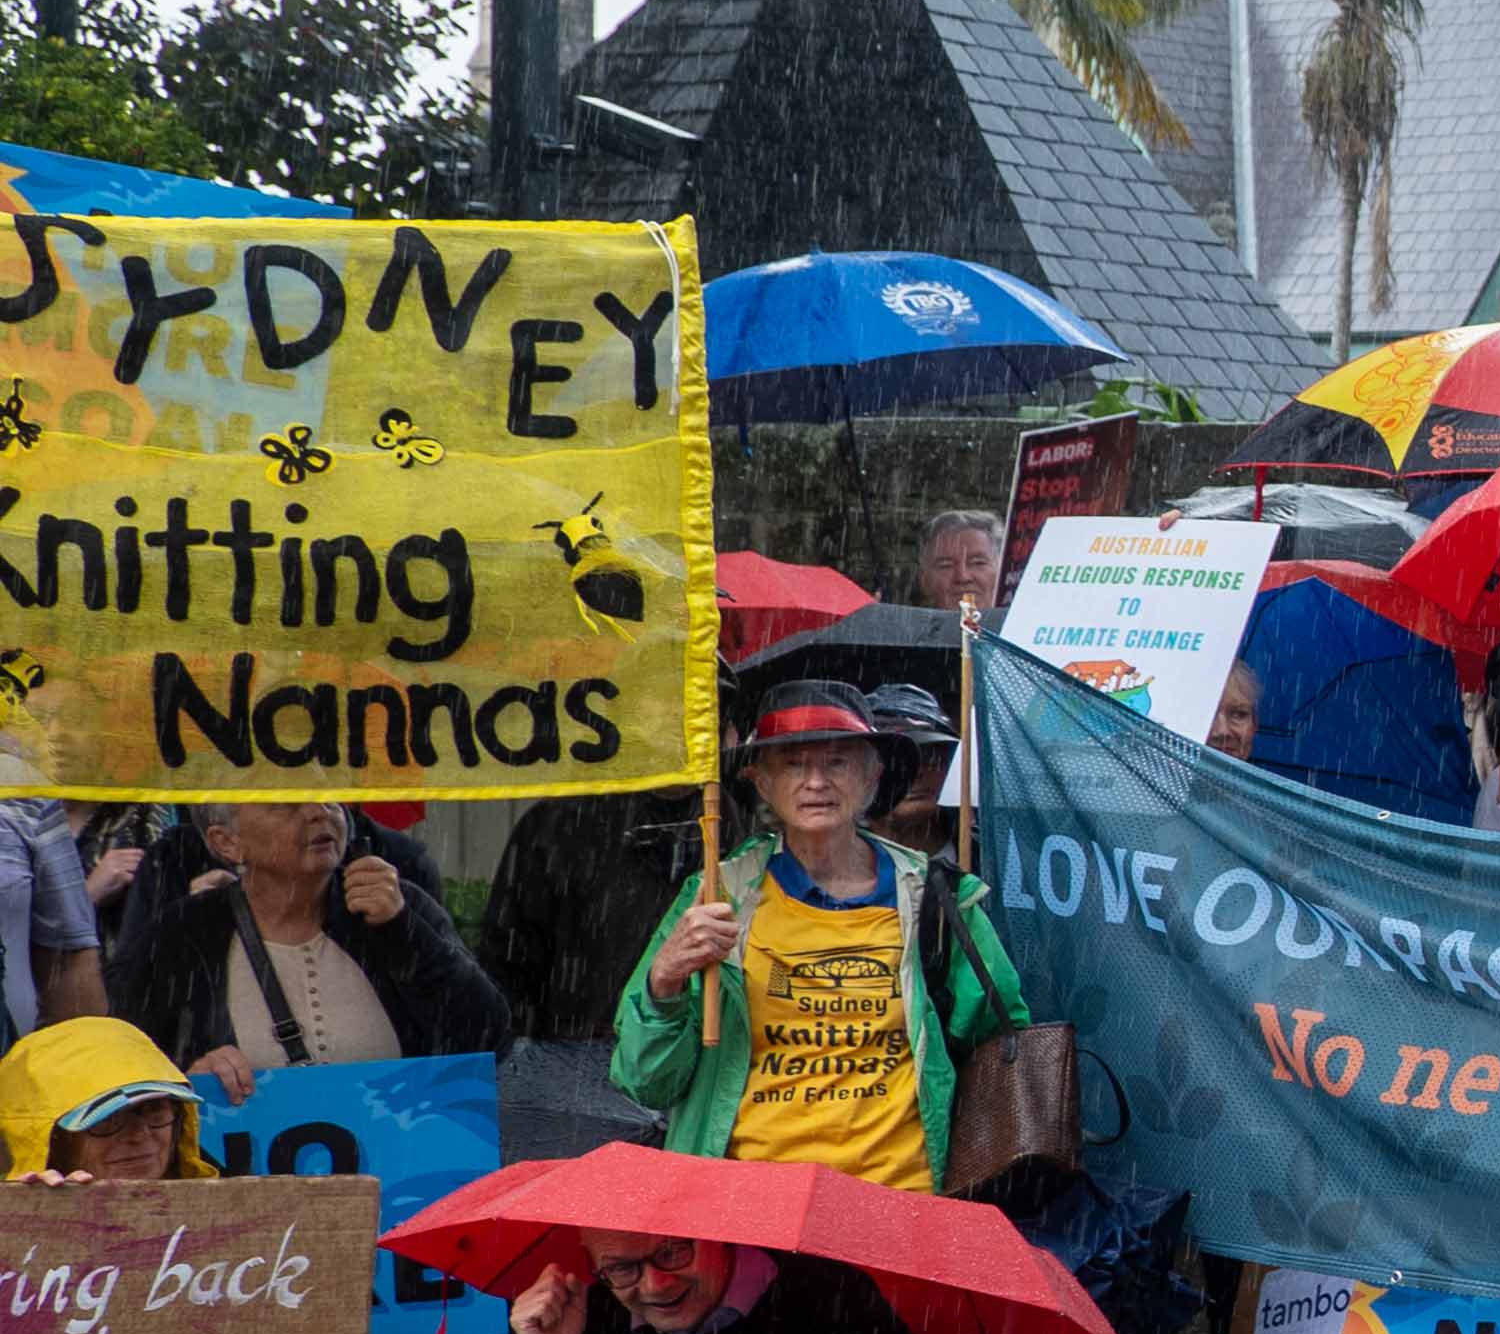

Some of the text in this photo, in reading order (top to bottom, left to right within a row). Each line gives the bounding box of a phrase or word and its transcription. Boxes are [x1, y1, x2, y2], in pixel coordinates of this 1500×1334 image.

[0, 214, 673, 438] SYDNEY
[1088, 535, 1208, 557] AUSTRALIAN
[1038, 565, 1244, 591] RELIGIOUS RESPONSE
[1117, 597, 1142, 616] TO
[1033, 626, 1205, 652] CLIMATE CHANGE
[152, 652, 620, 769] Nannas
[1002, 827, 1178, 934] LOVE
[1193, 867, 1394, 971] OUR
[798, 996, 888, 1017] Sydney
[764, 1022, 906, 1056] Knitting
[1252, 1003, 1366, 1099] No
[760, 1052, 899, 1078] Nannas
[753, 1085, 796, 1103] and
[145, 1222, 314, 1312] back
[1262, 1284, 1350, 1329] tambo
